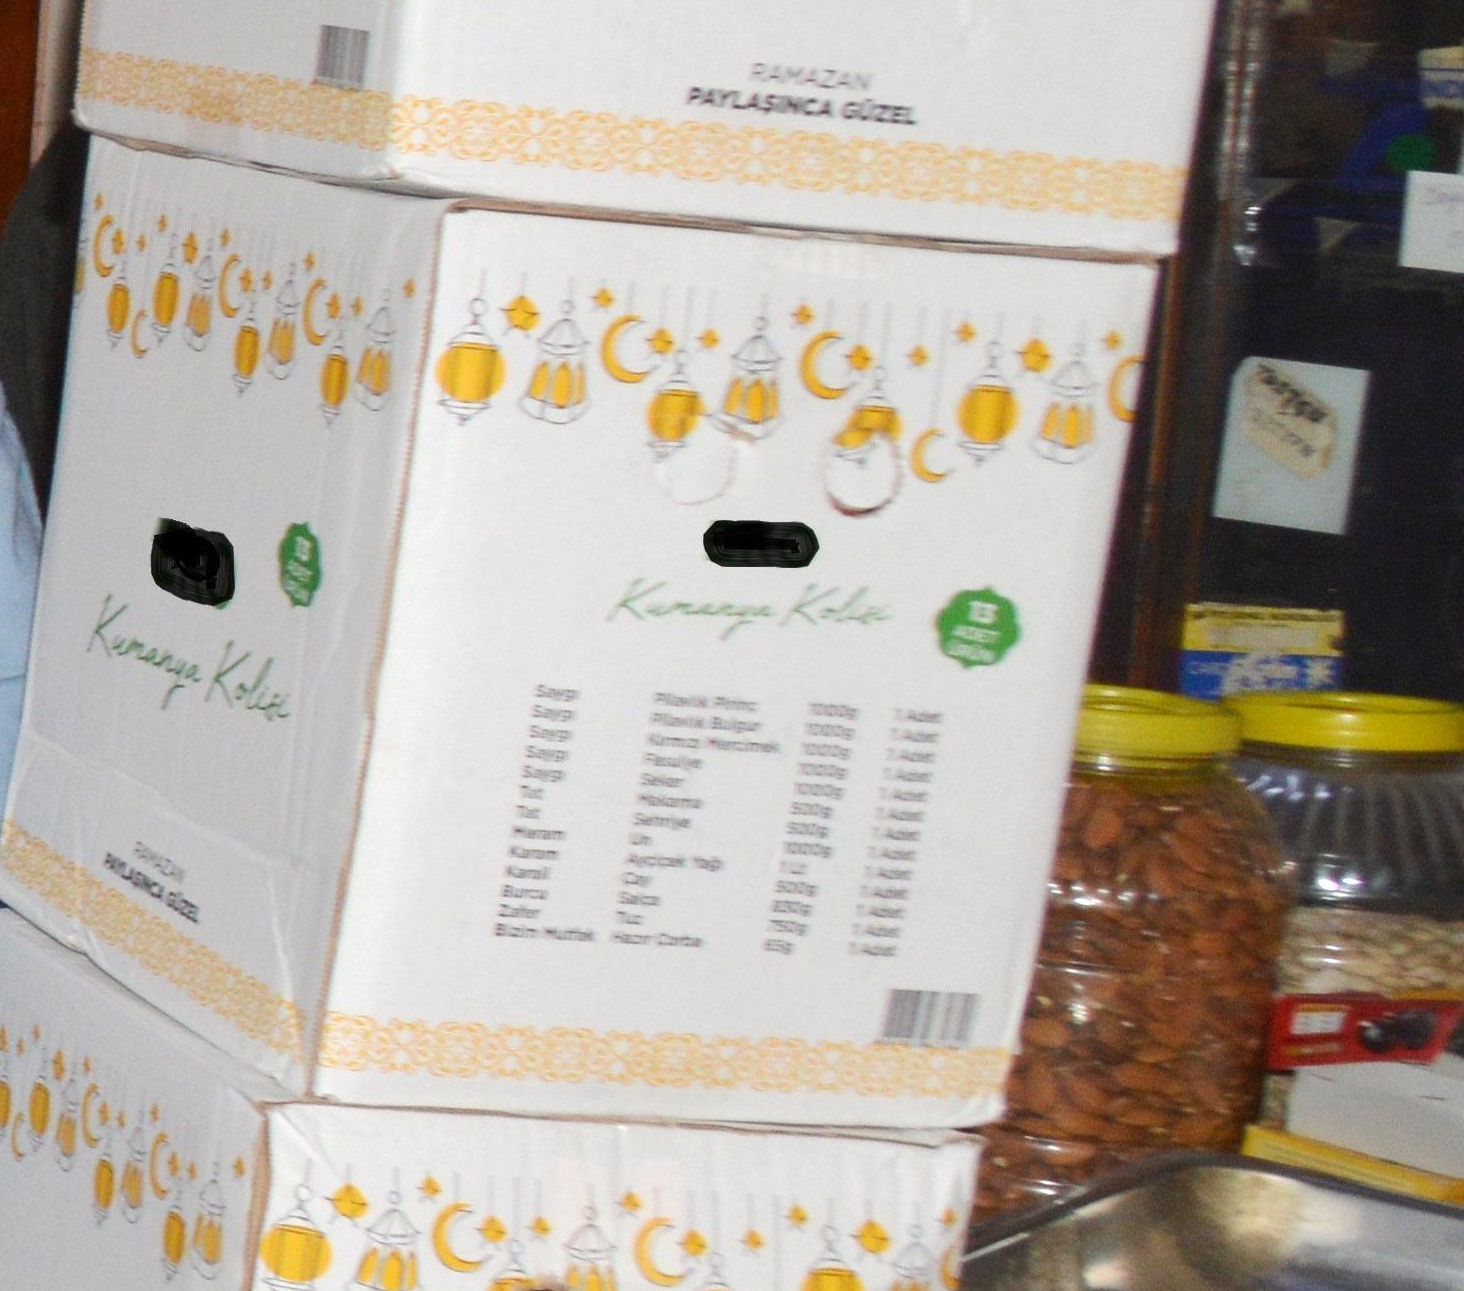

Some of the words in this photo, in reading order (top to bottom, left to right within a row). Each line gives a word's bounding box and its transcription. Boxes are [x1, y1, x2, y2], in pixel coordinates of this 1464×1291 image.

[750, 62, 876, 91] RAMAZAN
[686, 86, 835, 119] PAYLAŞINCA
[840, 98, 918, 125] GÜZEL
[606, 577, 773, 641] Kumanya
[779, 583, 891, 626] Kolisi
[968, 600, 999, 624] 13
[86, 594, 202, 710] Kumanya
[205, 640, 291, 721] Kolisi
[518, 784, 544, 800] Tat
[516, 804, 541, 819] Tat
